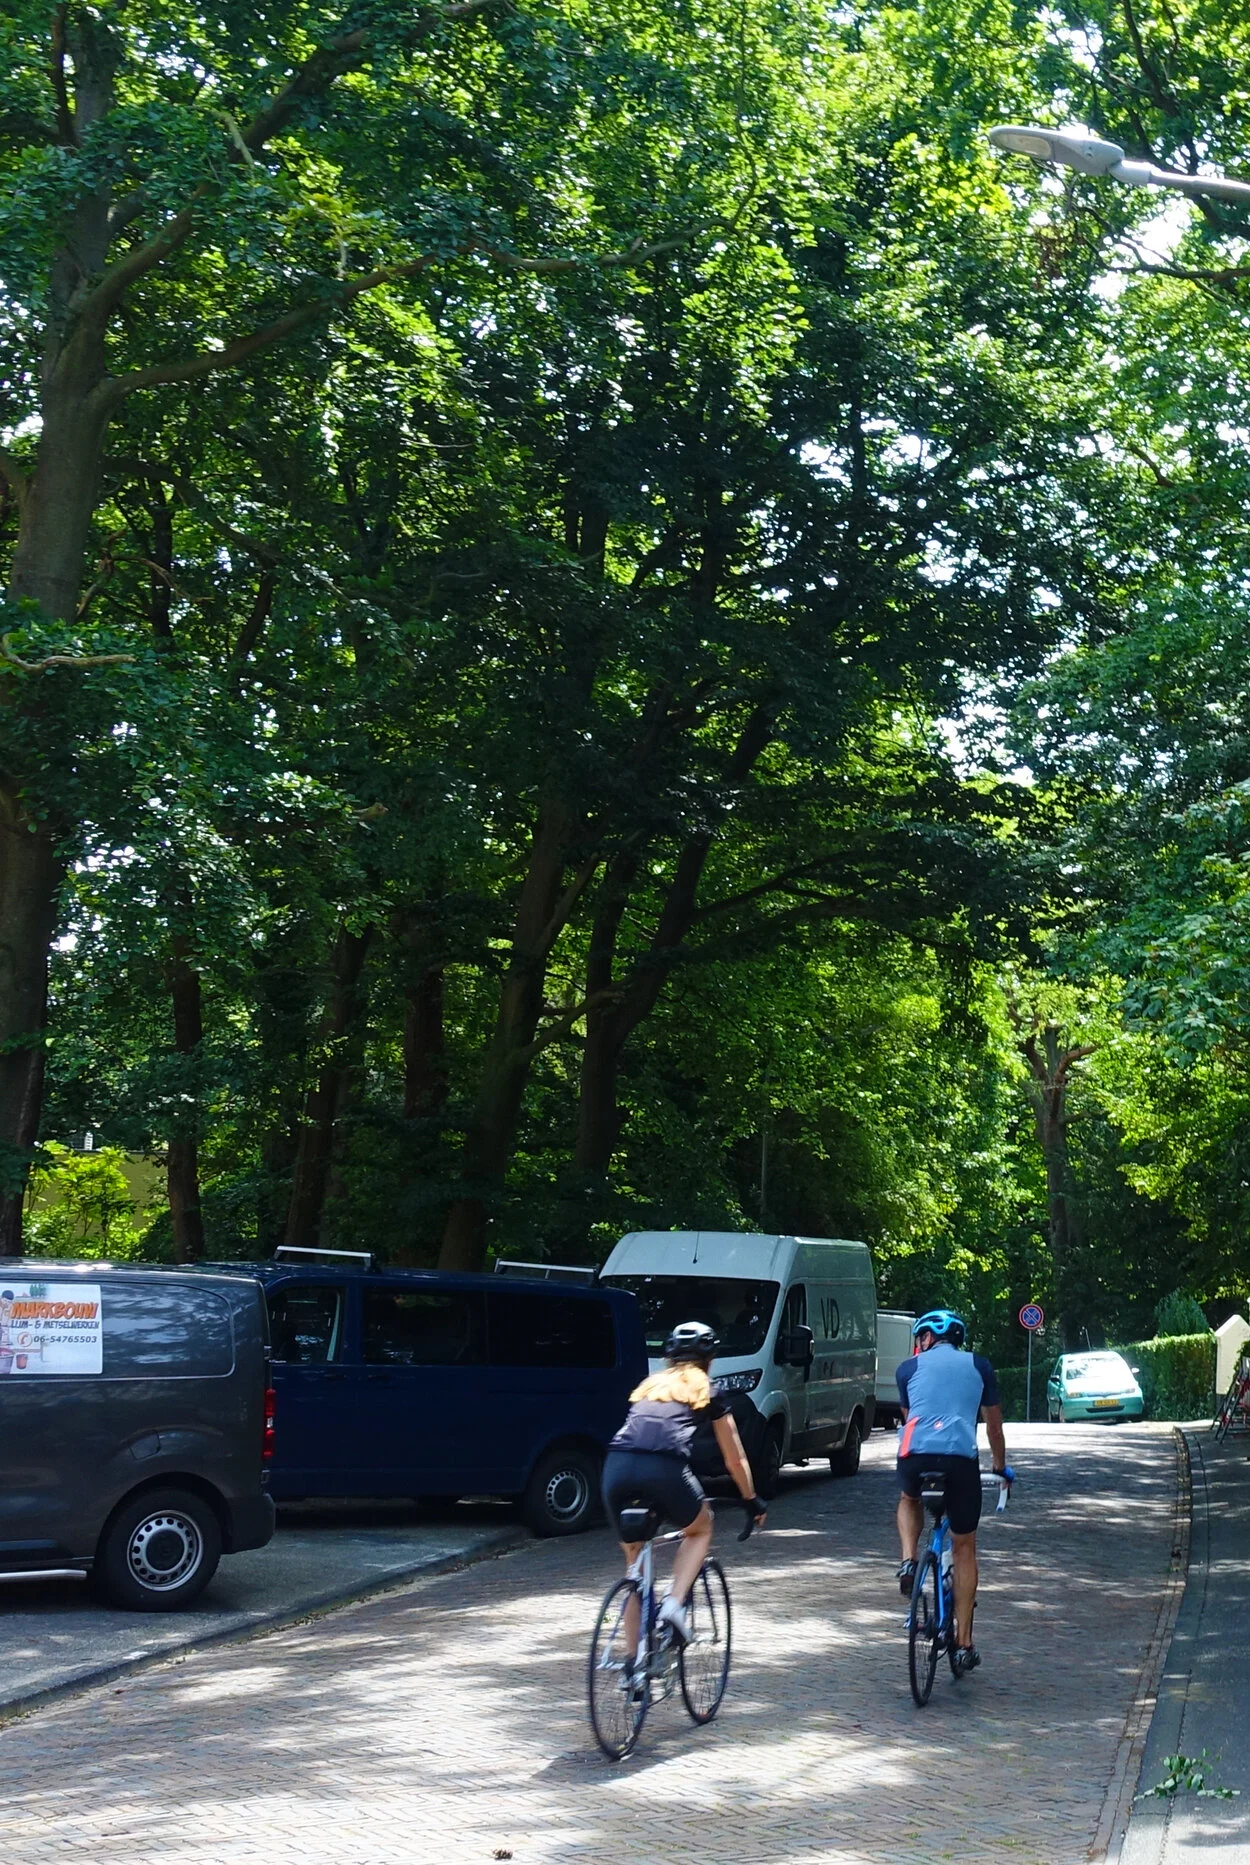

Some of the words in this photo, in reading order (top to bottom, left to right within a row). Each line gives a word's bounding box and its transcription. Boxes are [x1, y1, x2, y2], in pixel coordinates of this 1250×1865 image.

[11, 1302, 99, 1319] MARKBOUW
[34, 1320, 42, 1329] &
[43, 1321, 100, 1329] METSELWERKEN
[33, 1335, 97, 1343] 06-54765503
